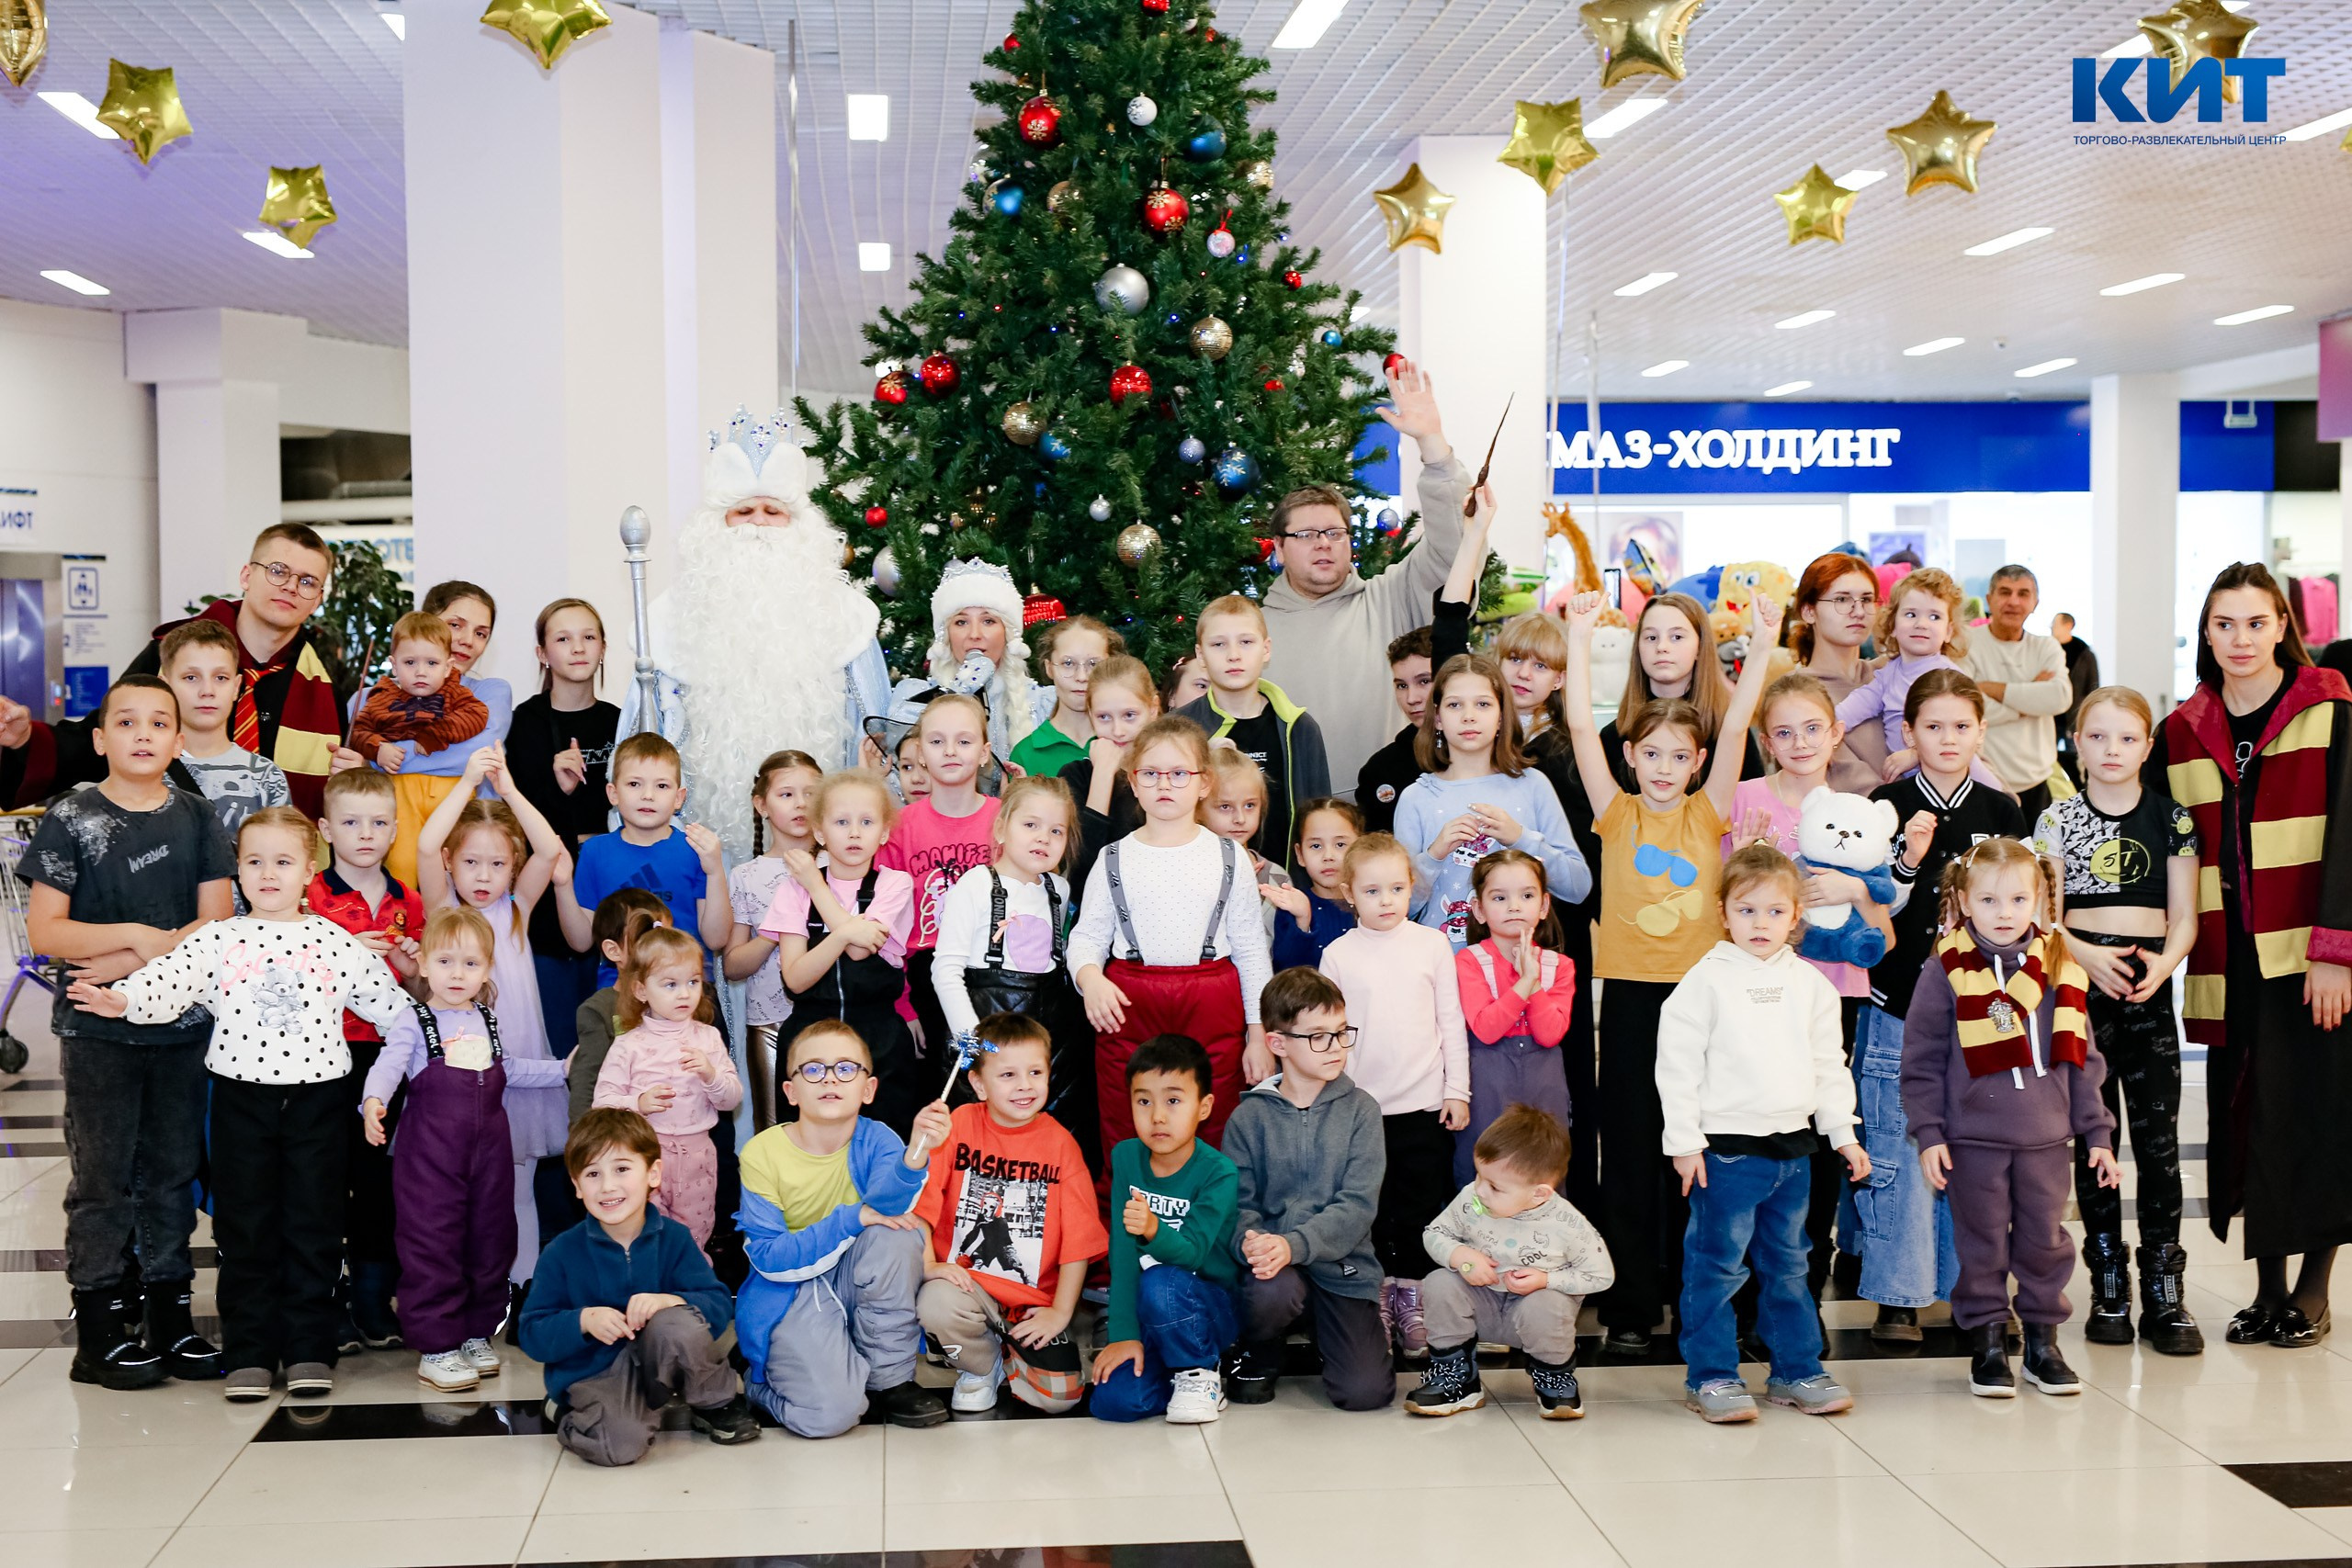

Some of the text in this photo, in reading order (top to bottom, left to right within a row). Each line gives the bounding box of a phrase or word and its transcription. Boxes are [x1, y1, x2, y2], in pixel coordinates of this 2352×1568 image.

[1547, 428, 1901, 475] МАЗ-ХОЛДИНГ
[0, 511, 33, 529] ИФТ
[910, 842, 992, 877] MANIFE
[954, 1142, 1060, 1184] BASKETBALL
[1129, 1185, 1191, 1217] RTY
[1521, 1250, 1548, 1267] COOL
